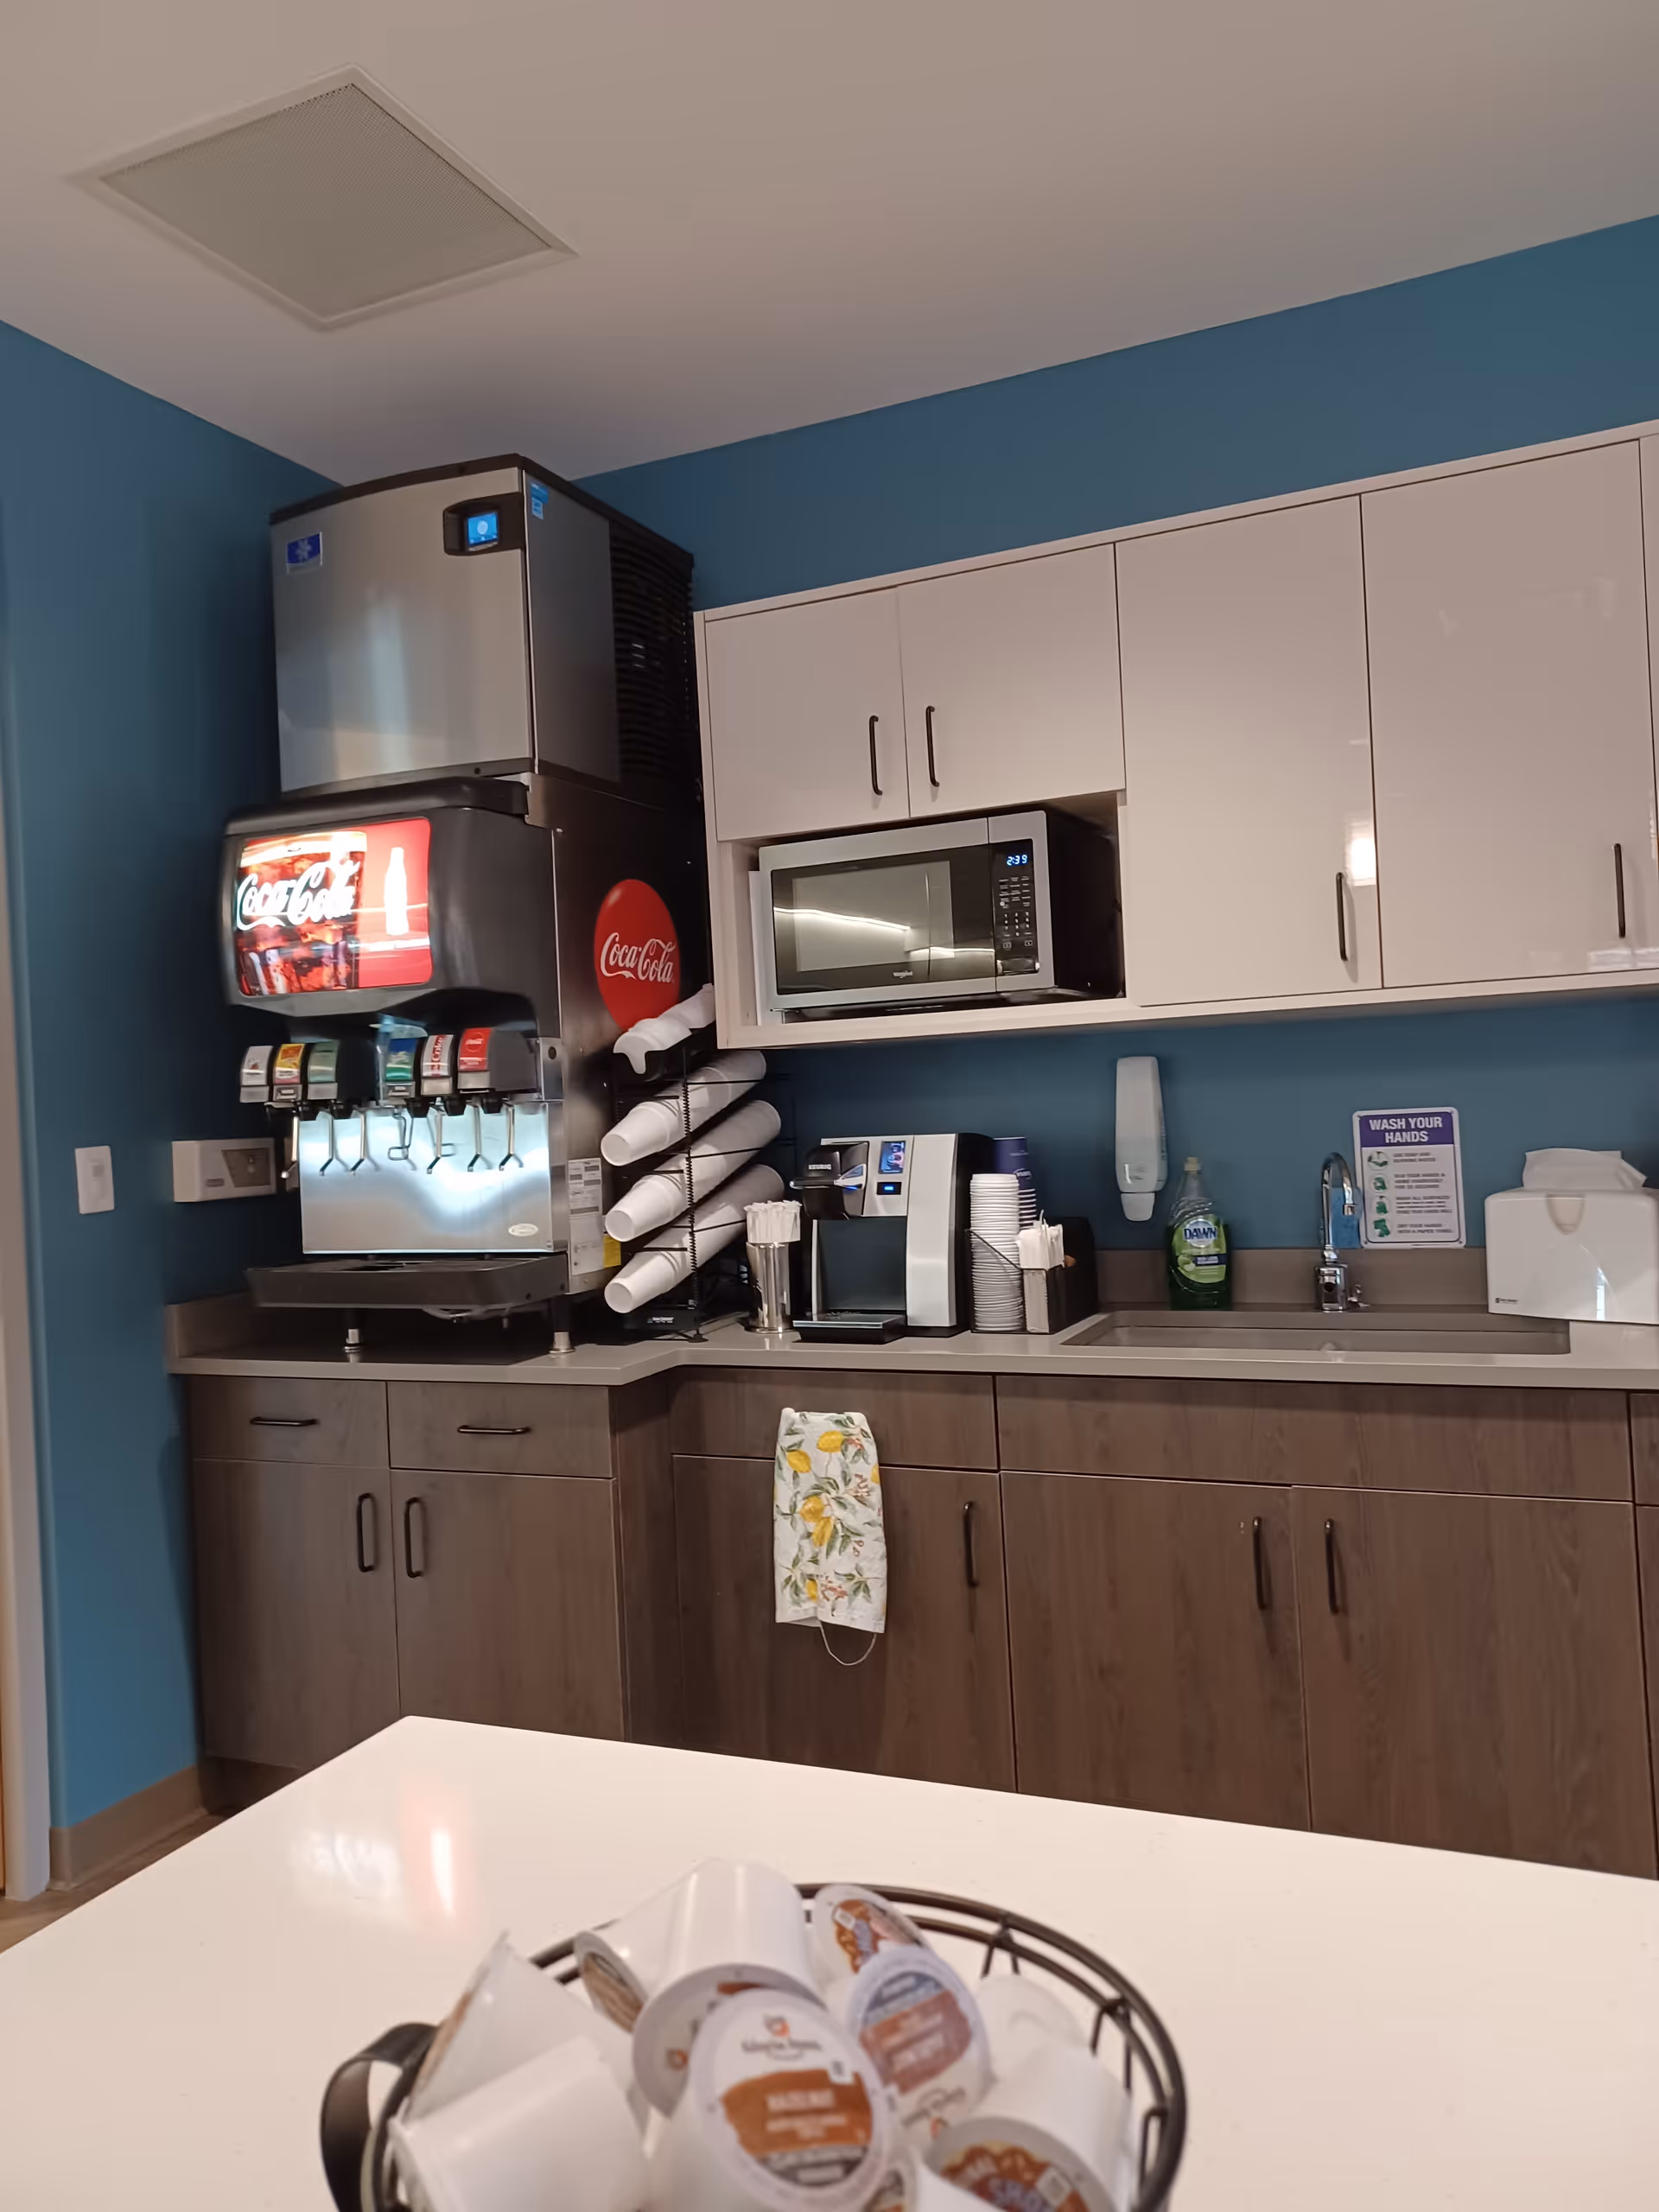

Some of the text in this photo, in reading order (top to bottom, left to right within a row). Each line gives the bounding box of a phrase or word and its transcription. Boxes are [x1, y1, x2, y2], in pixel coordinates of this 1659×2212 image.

[1007, 854, 1028, 866] 2:39
[237, 860, 361, 931] Coca-Cola
[601, 932, 676, 983] Coca-Cola
[1369, 1116, 1443, 1131] WASH YOUR
[1384, 1130, 1429, 1143] HANDS
[1184, 1227, 1217, 1240] DAWN
